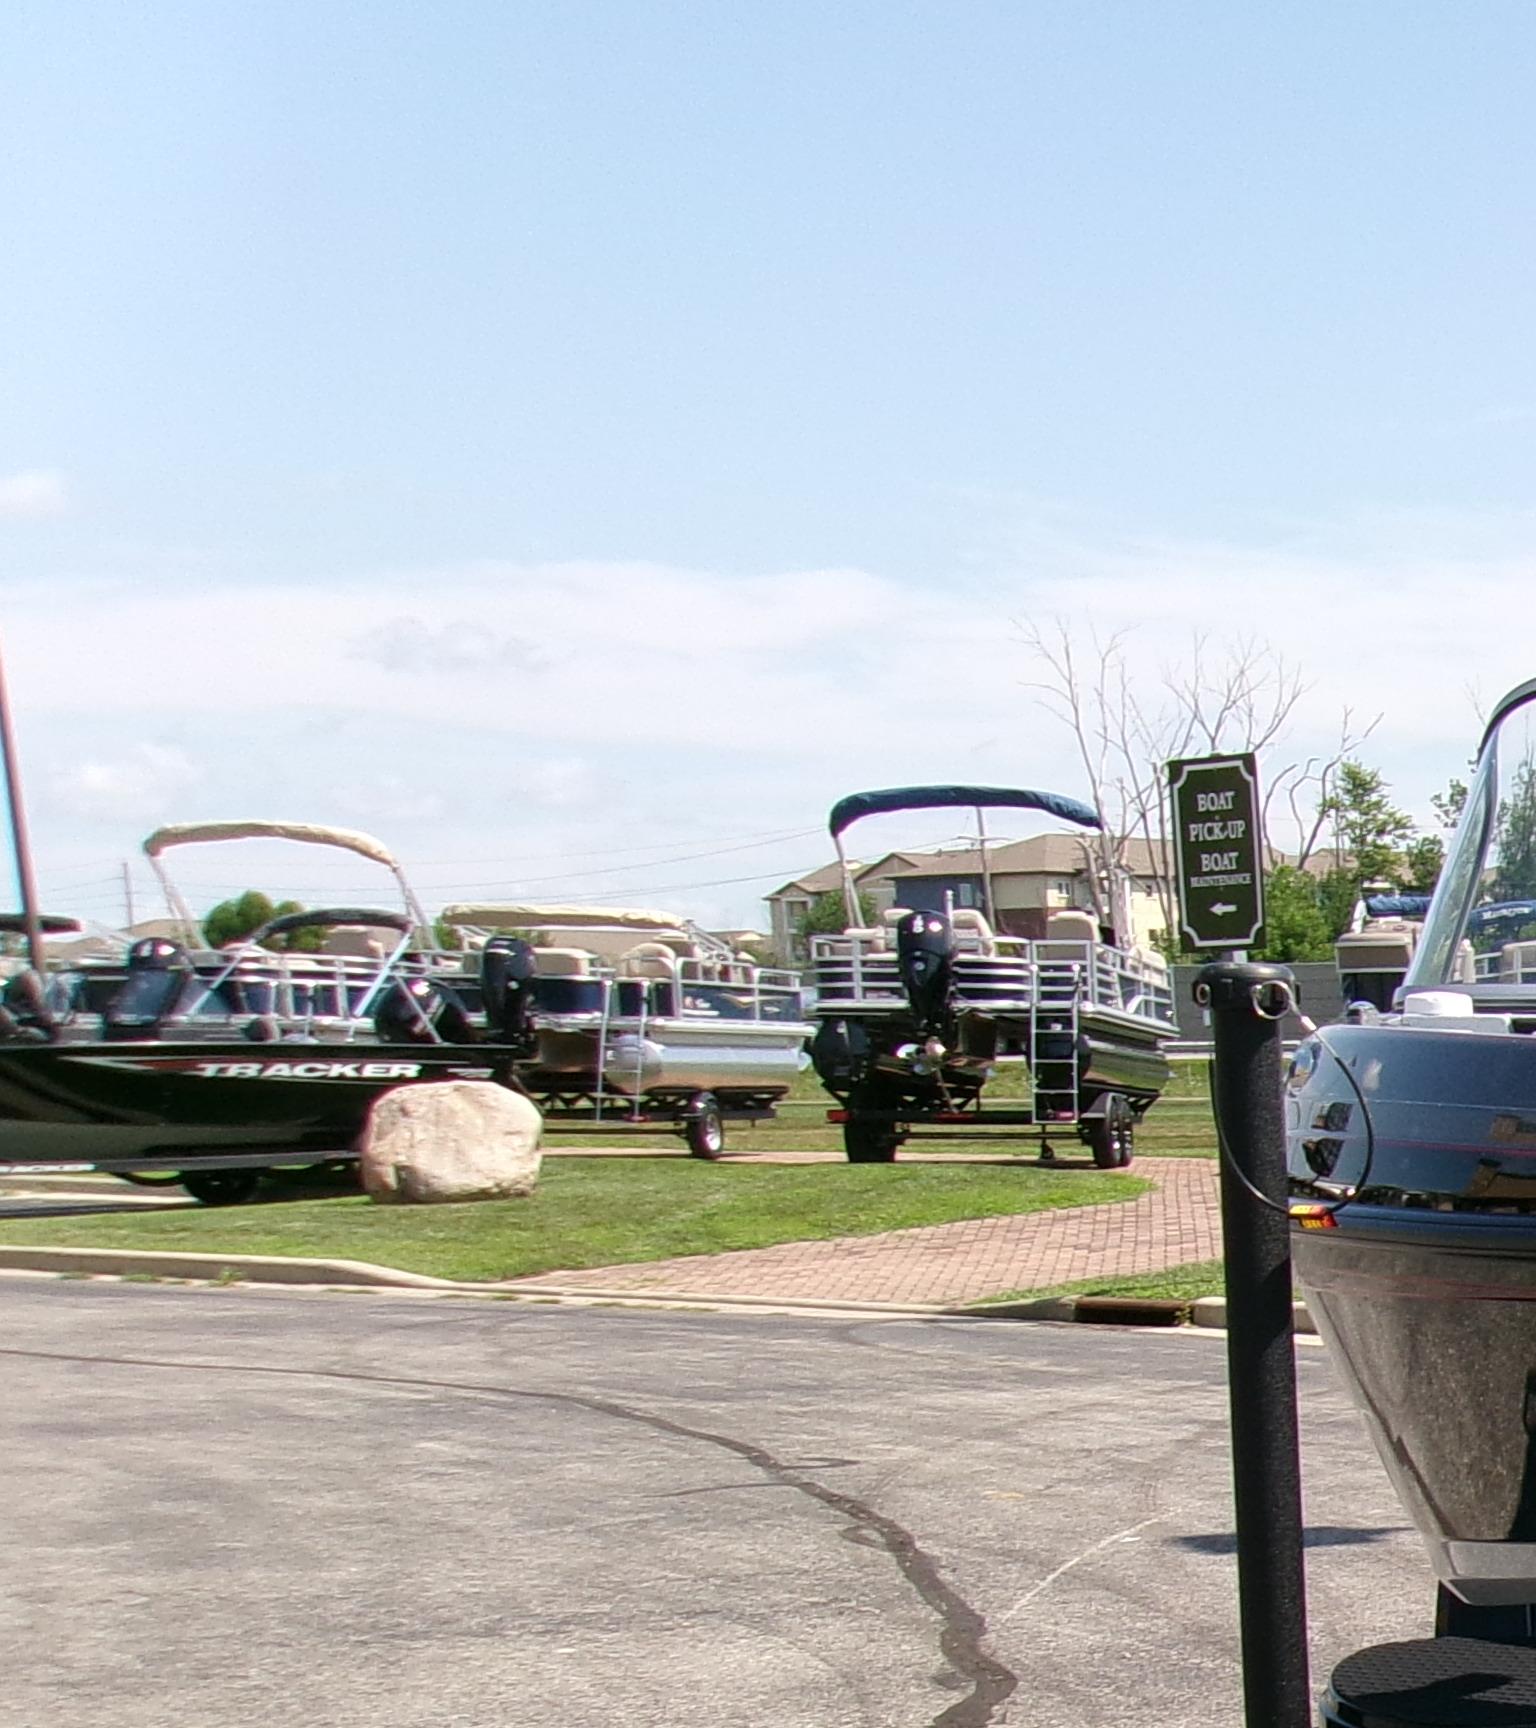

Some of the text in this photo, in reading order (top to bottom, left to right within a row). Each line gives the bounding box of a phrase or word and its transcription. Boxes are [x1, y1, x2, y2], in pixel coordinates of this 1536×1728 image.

[1196, 791, 1235, 812] BOAT
[1189, 820, 1246, 842] PICK-UP
[1200, 851, 1239, 872] BOAT
[197, 1062, 422, 1079] TRACKER
